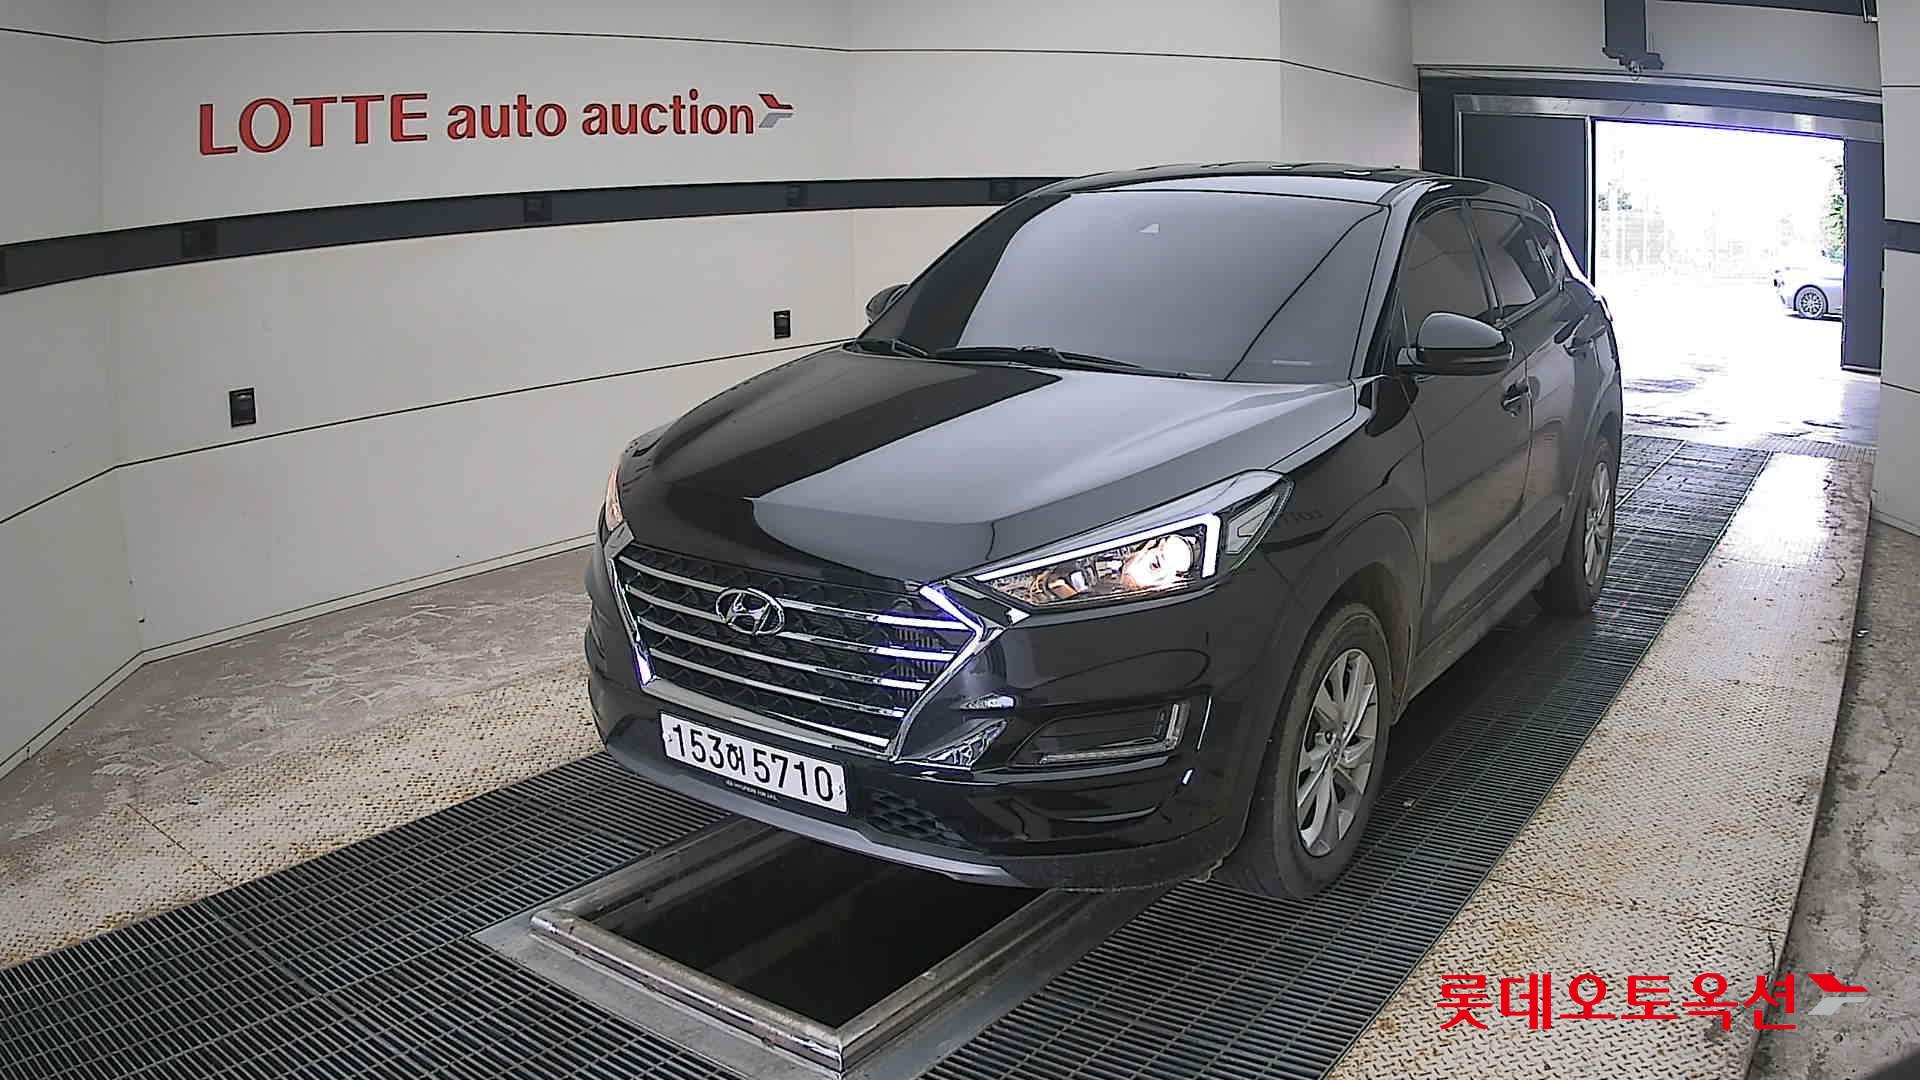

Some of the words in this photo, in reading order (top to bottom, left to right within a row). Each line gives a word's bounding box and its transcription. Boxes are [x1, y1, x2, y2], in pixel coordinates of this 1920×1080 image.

[200, 92, 429, 156] LOTTE
[446, 93, 568, 140] auto
[581, 88, 756, 136] auction
